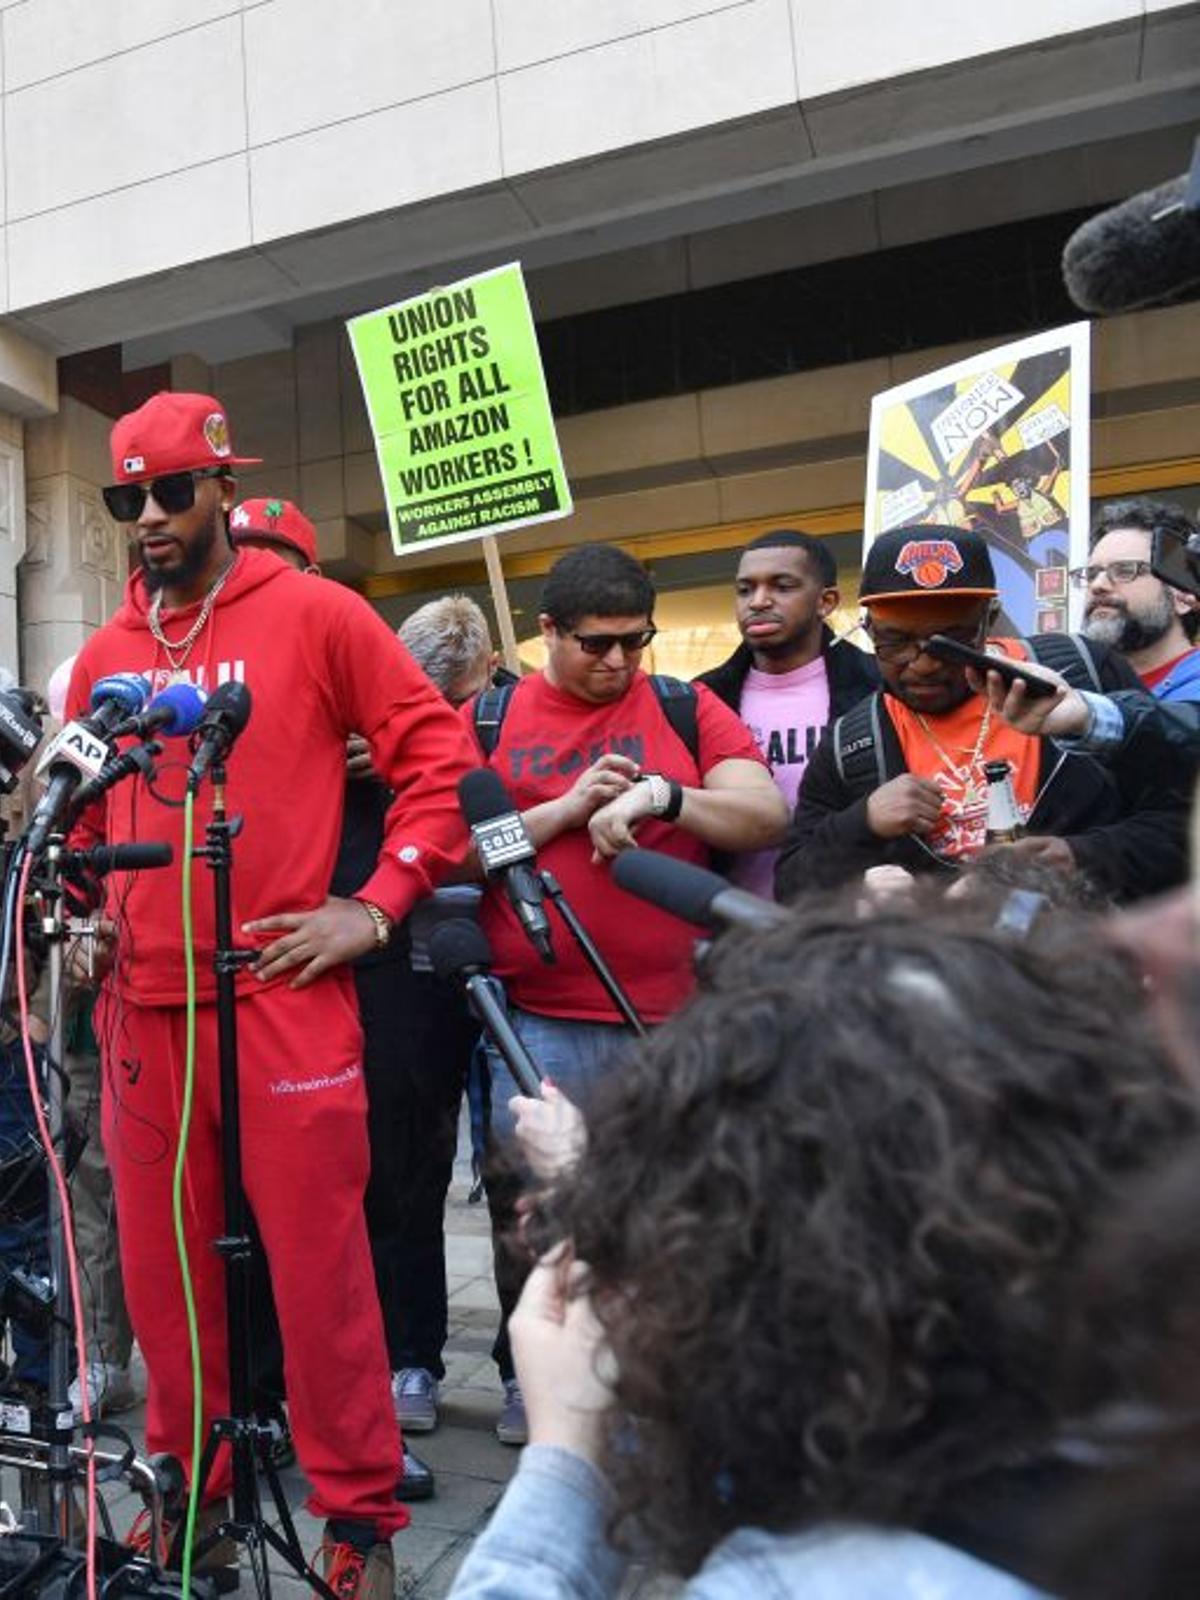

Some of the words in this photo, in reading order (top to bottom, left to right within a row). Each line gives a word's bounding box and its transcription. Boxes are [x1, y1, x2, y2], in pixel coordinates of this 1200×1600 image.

[387, 288, 477, 345] UNION
[393, 326, 490, 384] RIGHTS
[400, 379, 450, 421] FOR
[458, 362, 511, 404] ALL
[409, 403, 510, 456] AMAZON
[944, 385, 1013, 454] NOW
[398, 496, 471, 523] WORKERS
[473, 475, 552, 506] ASSEMBLY
[417, 513, 477, 537] AGAINST
[480, 498, 540, 522] RACISM
[66, 733, 103, 760] AP
[482, 828, 524, 852] COUP
